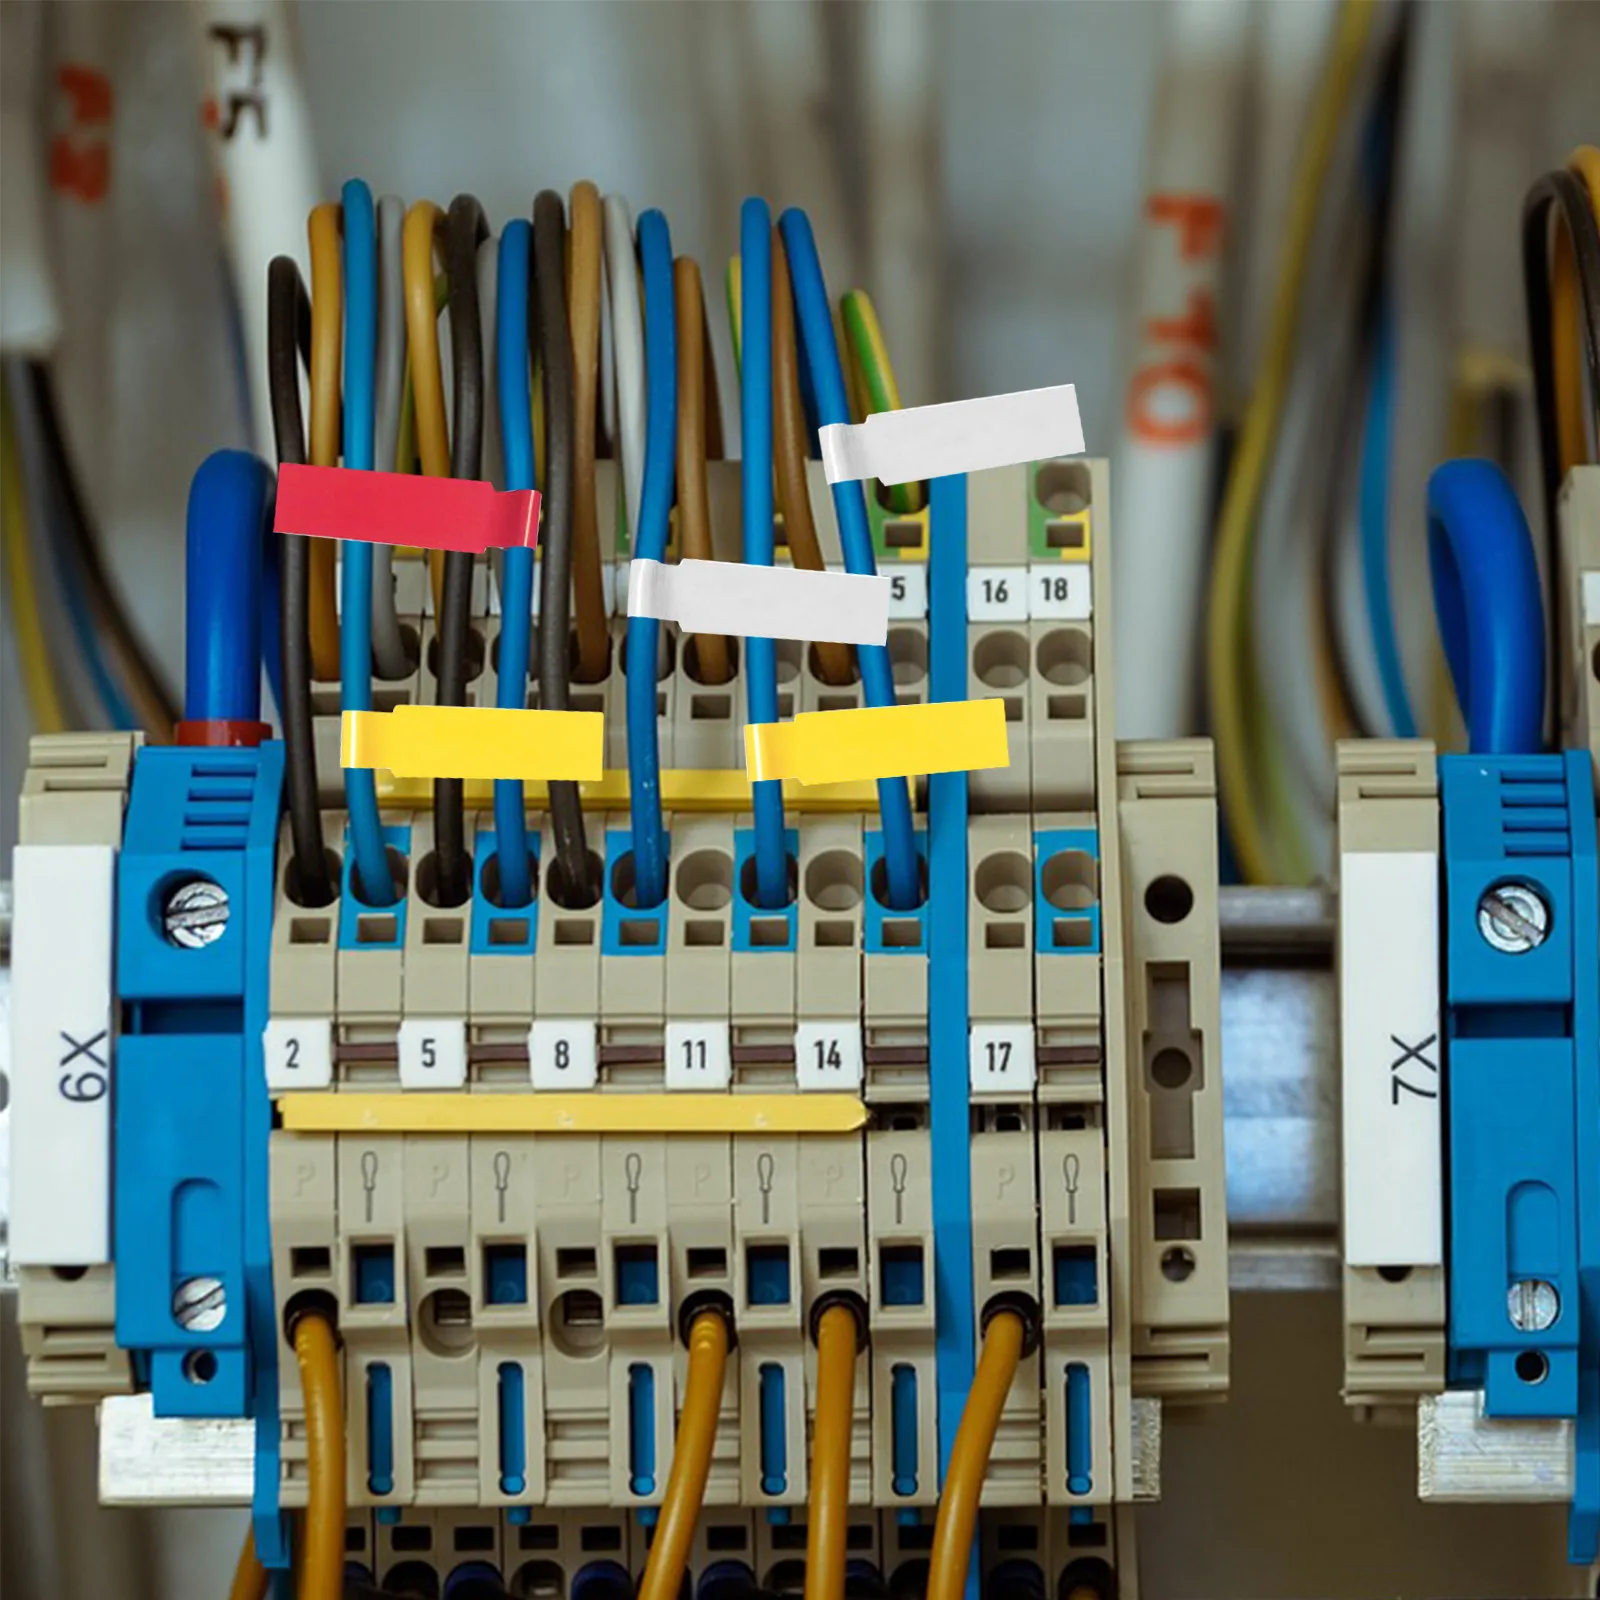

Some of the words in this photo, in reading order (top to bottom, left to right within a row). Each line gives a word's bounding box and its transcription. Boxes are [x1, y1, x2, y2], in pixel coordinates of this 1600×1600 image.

[882, 575, 906, 602] 5
[982, 579, 1009, 603] 16
[1041, 577, 1069, 601] 18
[59, 1029, 108, 1103] 6X
[286, 1038, 299, 1069] 2
[421, 1038, 436, 1068] 5
[555, 1039, 570, 1070] 8
[682, 1040, 707, 1069] 11
[814, 1040, 842, 1070] 14
[985, 1041, 1012, 1072] 17
[1390, 1033, 1437, 1105] 7X
